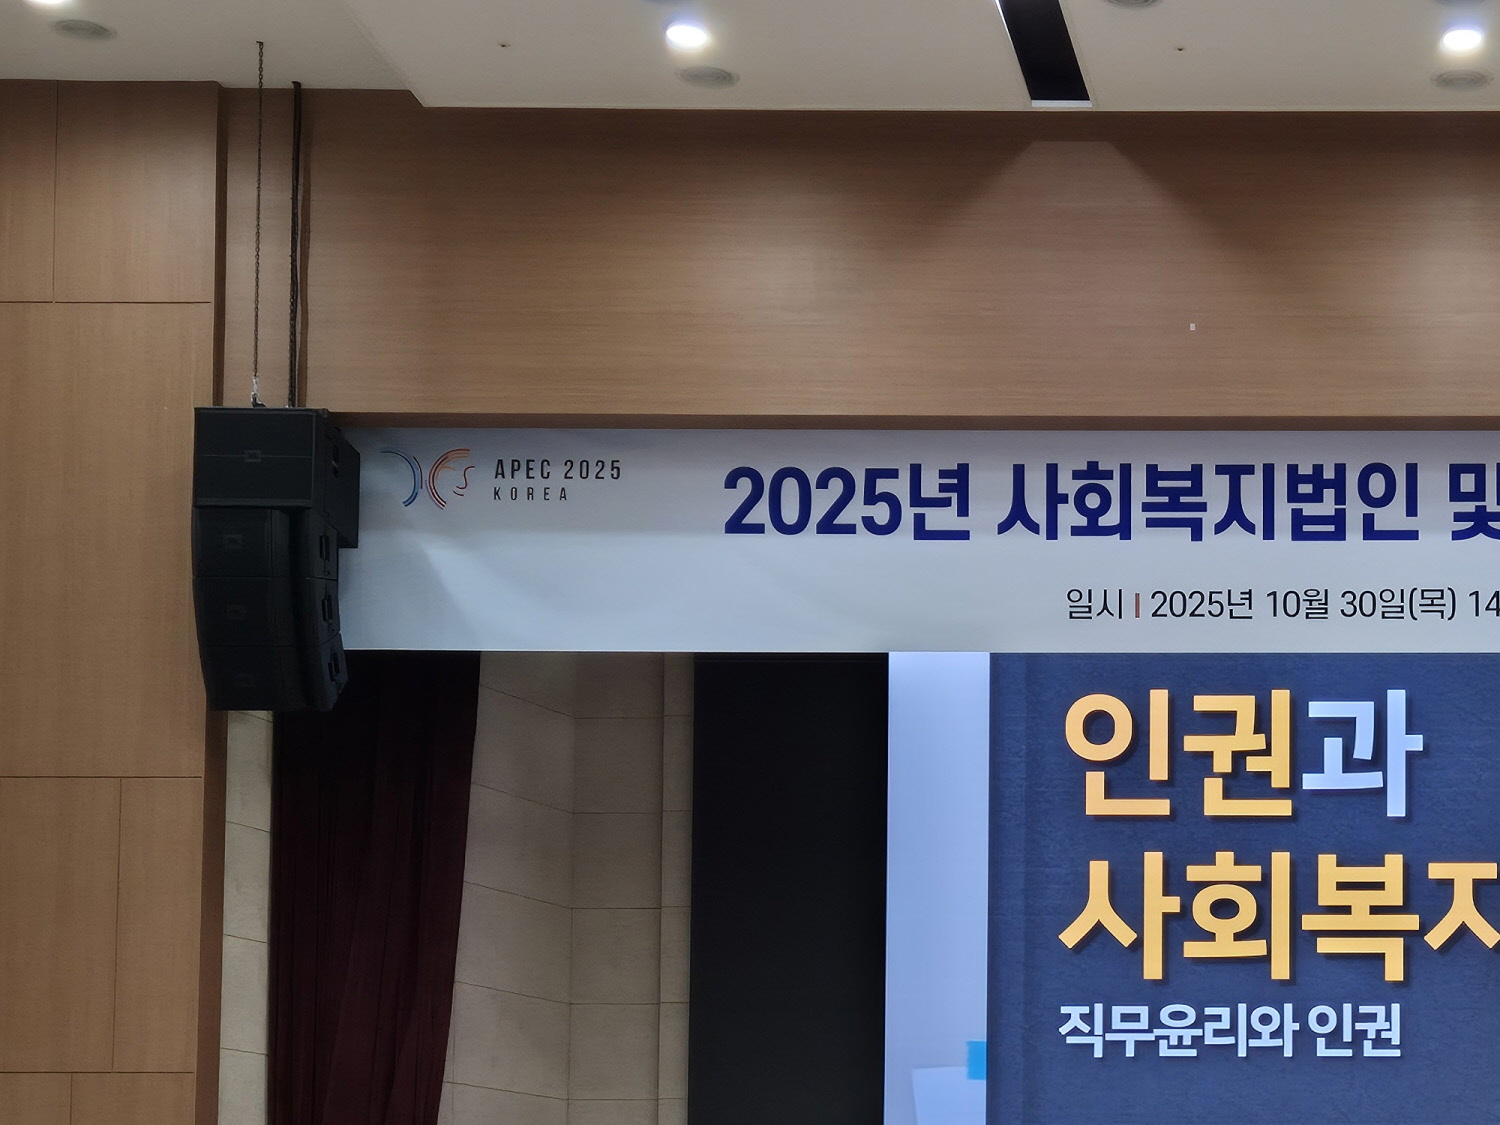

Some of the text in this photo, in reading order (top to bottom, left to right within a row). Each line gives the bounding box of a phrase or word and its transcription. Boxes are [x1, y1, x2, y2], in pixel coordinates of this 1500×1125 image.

[493, 458, 621, 480] APEC 2025
[493, 486, 568, 501] KOREA
[723, 462, 971, 541] 2025년
[997, 460, 1420, 542] 사회복지법인
[1066, 588, 1124, 620] 일시
[1150, 588, 1254, 620] 2025년
[1266, 588, 1330, 620] 10월
[1340, 586, 1457, 621] 30일(목)
[1065, 688, 1424, 818] 인권과
[1058, 1002, 1402, 1058] 직무윤리와 인권
